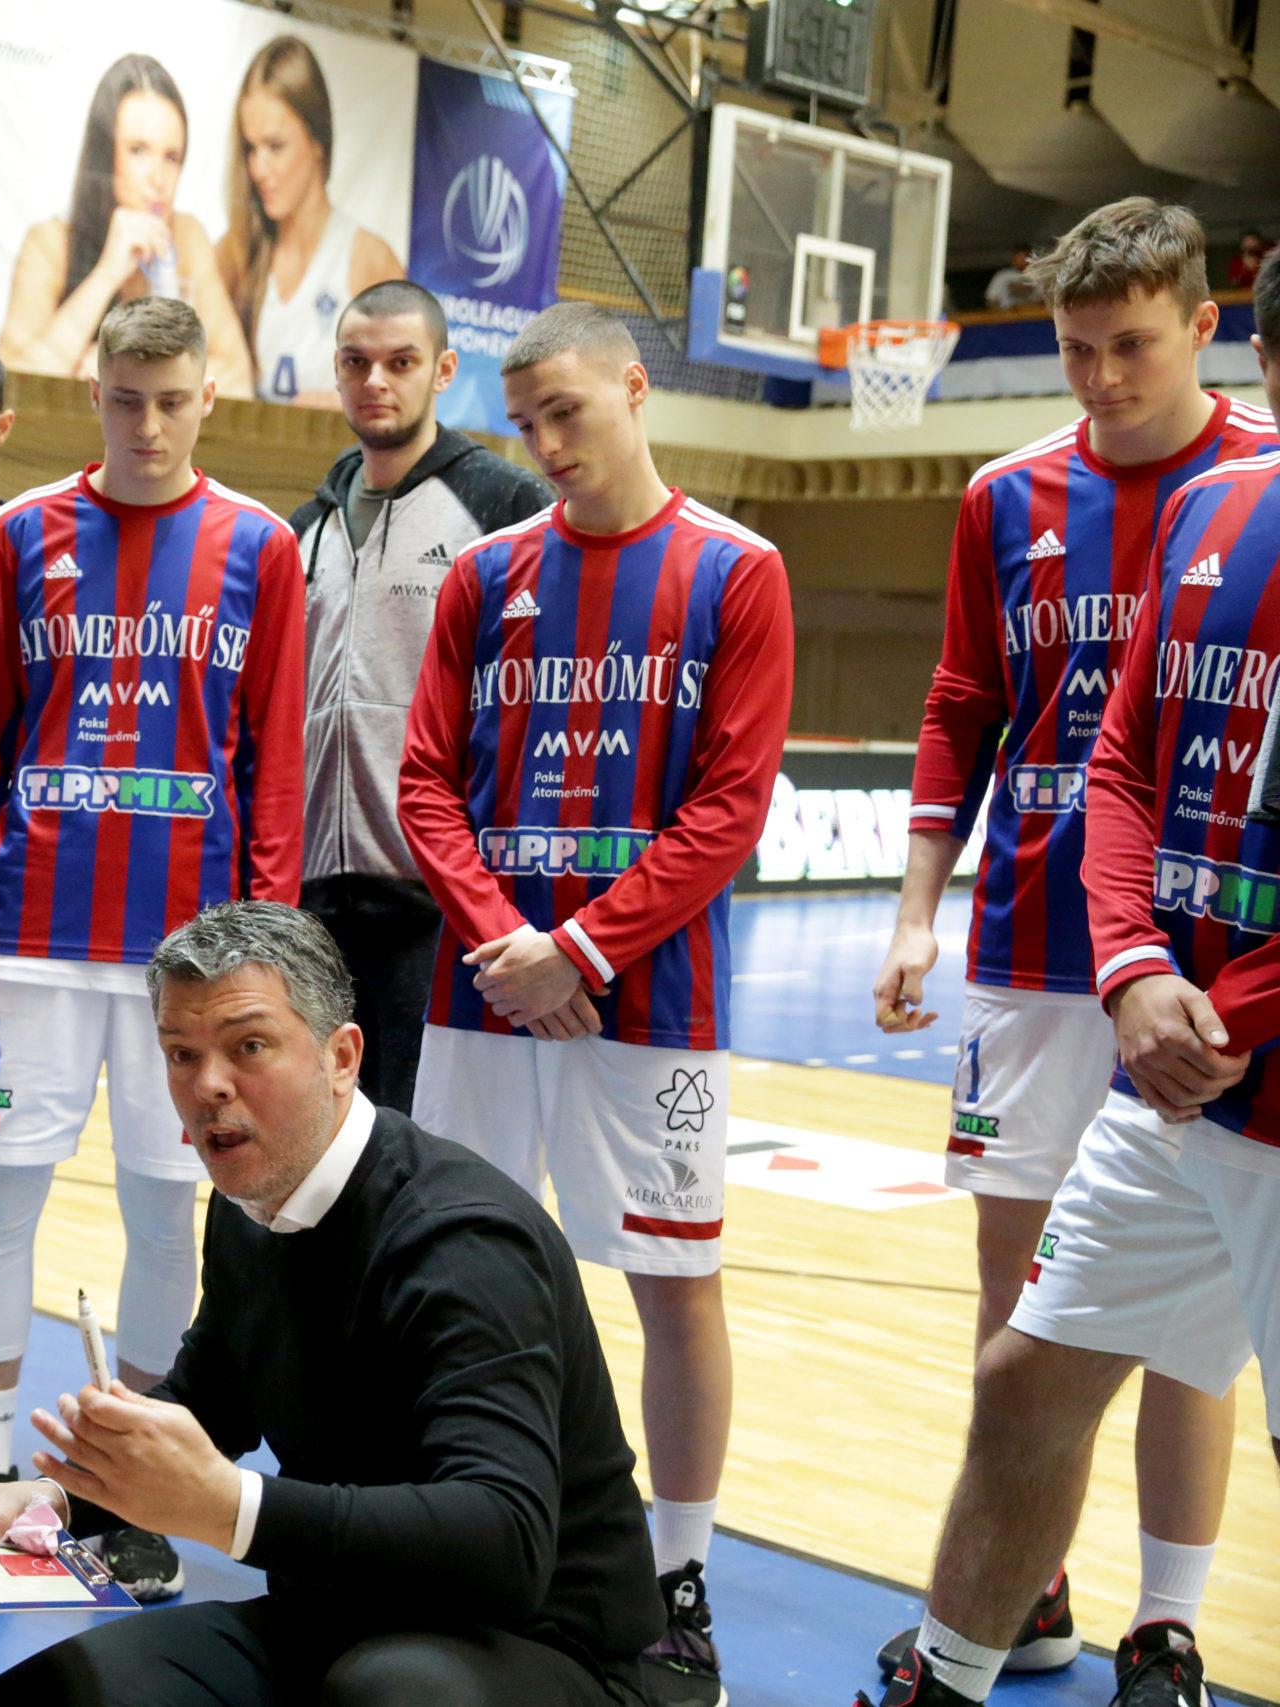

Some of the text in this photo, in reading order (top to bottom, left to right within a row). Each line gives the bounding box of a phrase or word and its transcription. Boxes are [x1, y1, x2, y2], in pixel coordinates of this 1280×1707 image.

[1026, 544, 1066, 560] adidas
[418, 556, 452, 568] adidas
[45, 568, 83, 579] adidas
[1180, 572, 1224, 588] adidas
[390, 584, 428, 597] MVM
[502, 607, 541, 619] adidas
[211, 622, 251, 673] SE
[78, 680, 171, 707] MVM
[1068, 710, 1102, 723] Paksi
[78, 717, 109, 730] Paksi
[76, 730, 141, 742] Atomerőmű
[533, 729, 631, 757] MVM
[534, 771, 565, 784] Paksi
[21, 770, 212, 815] TiPPMIX
[532, 786, 600, 799] Atomerőmű
[1178, 784, 1213, 804] Paksi
[1174, 804, 1248, 830] Atomerőmű
[664, 1139, 701, 1152] PAKS
[624, 1186, 713, 1209] MERCARIUS
